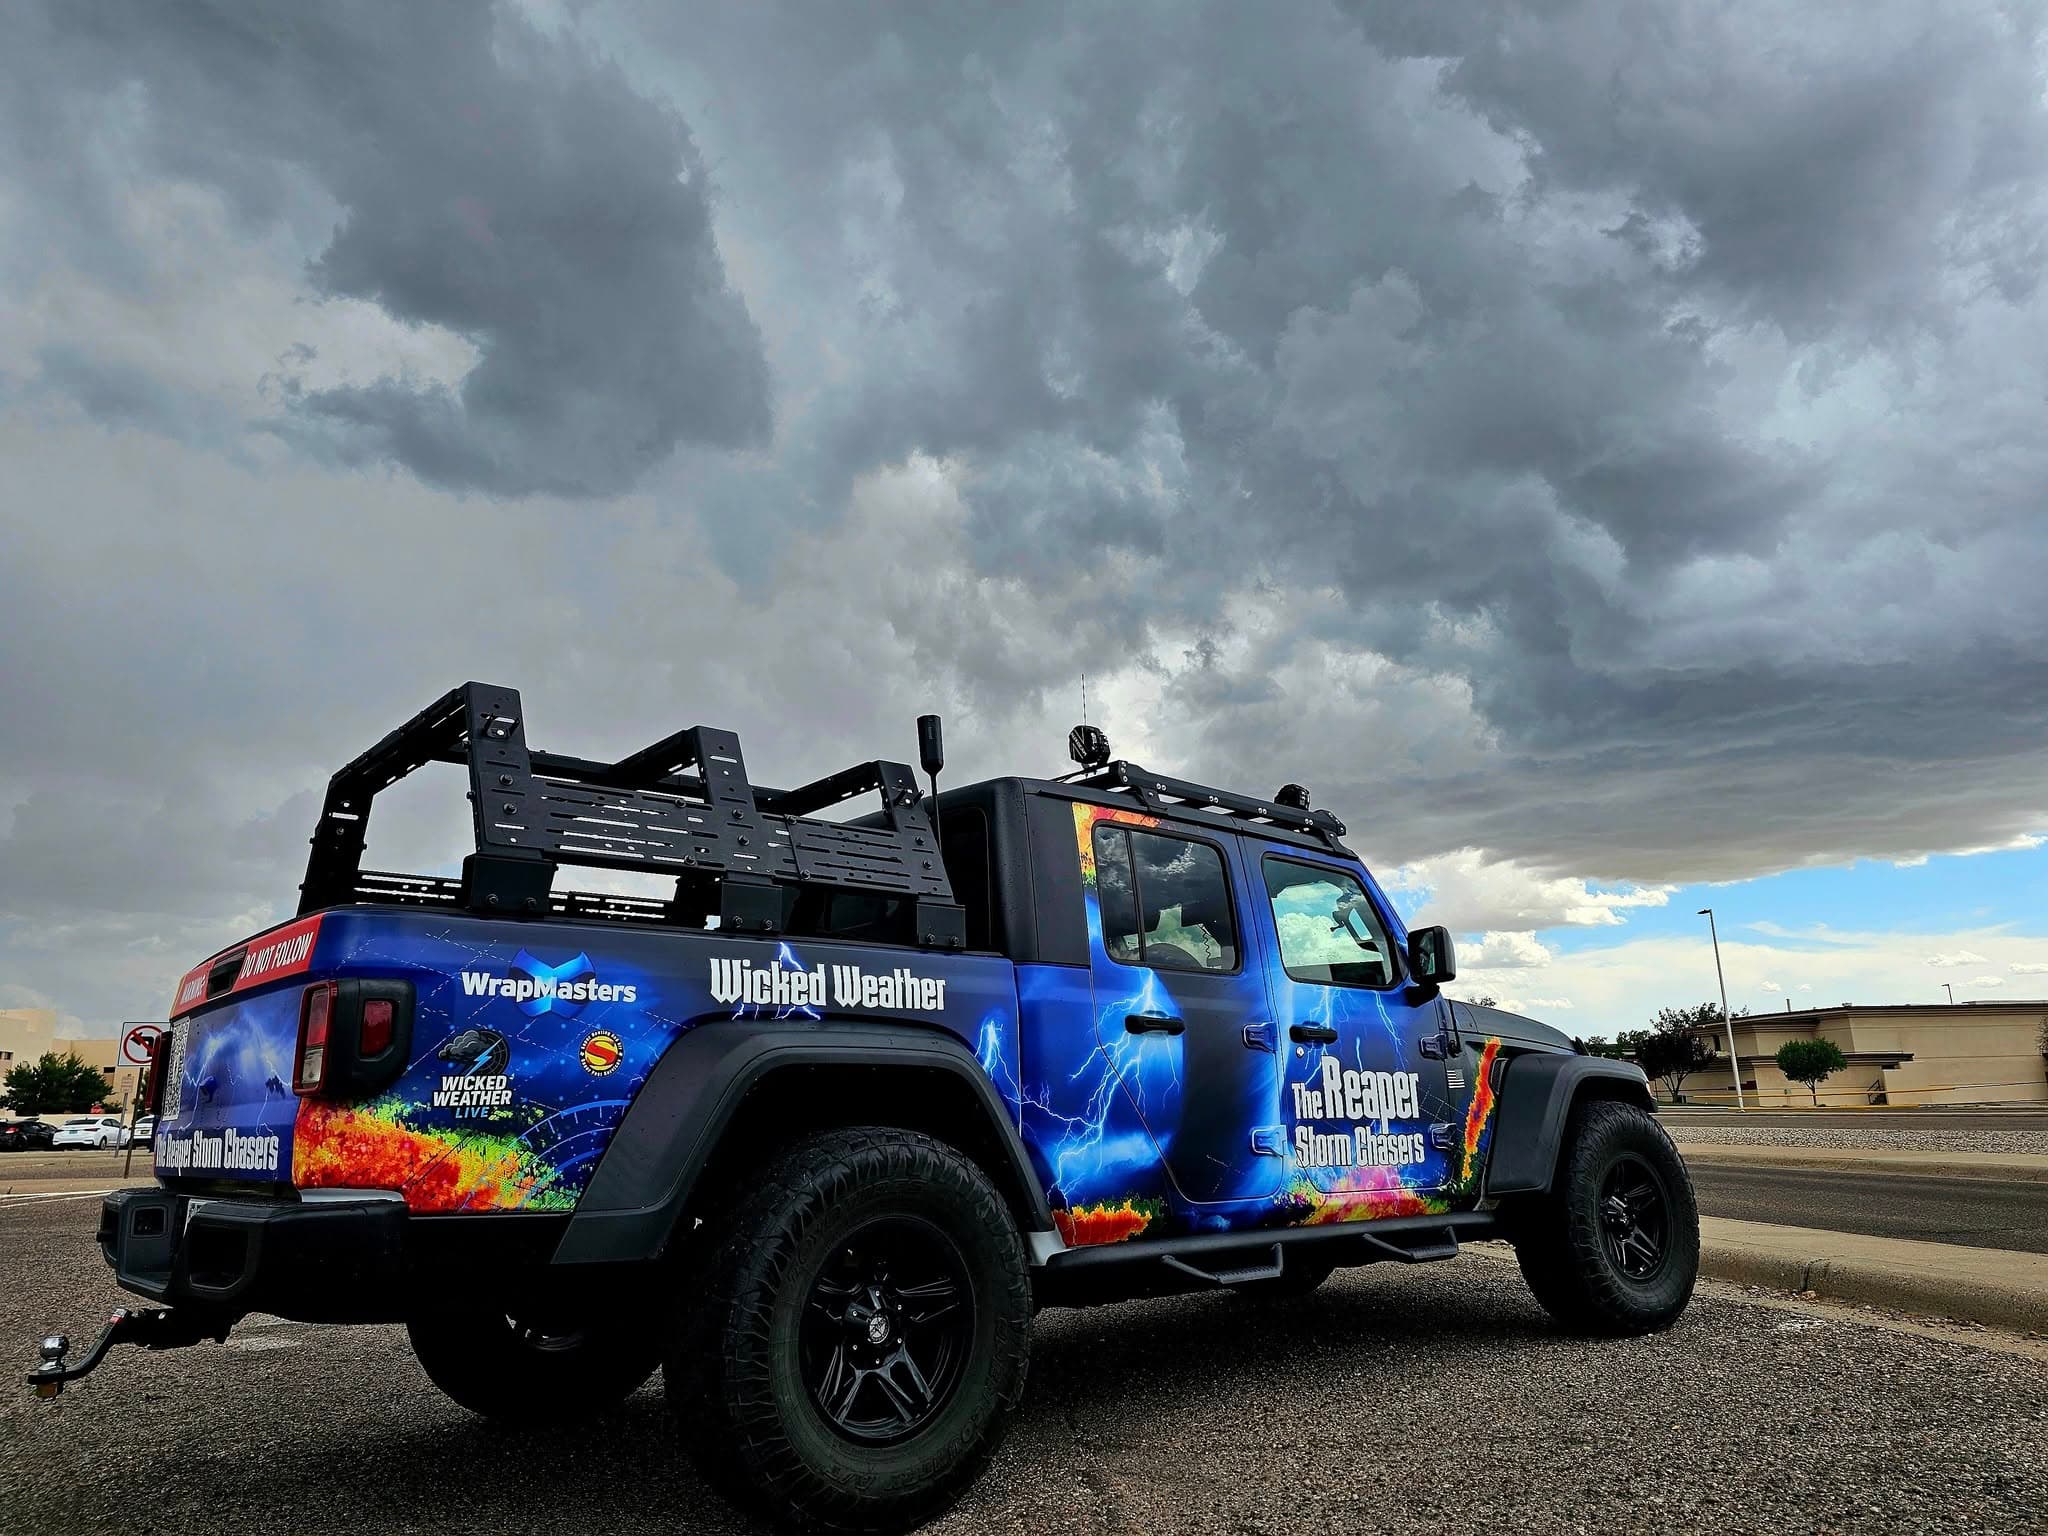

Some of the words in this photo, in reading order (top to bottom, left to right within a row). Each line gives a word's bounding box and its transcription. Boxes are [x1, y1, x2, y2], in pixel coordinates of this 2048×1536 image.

[240, 952, 256, 979] DO
[253, 945, 276, 976] NOT
[271, 931, 314, 969] FOLLOW
[461, 971, 637, 1003] WrapMasters
[709, 958, 827, 1006] Wicked
[832, 964, 946, 1011] Weather
[433, 1089, 512, 1107] WEATHER
[441, 1075, 507, 1091] WICKED
[1291, 1083, 1323, 1119] The
[1321, 1055, 1420, 1134] Reaper
[455, 1106, 491, 1119] LIVE
[166, 1133, 193, 1176] Reaper
[192, 1130, 223, 1168] Storm
[223, 1128, 279, 1171] Chasers
[1295, 1126, 1353, 1168] Storm
[1354, 1126, 1426, 1168] Chasers
